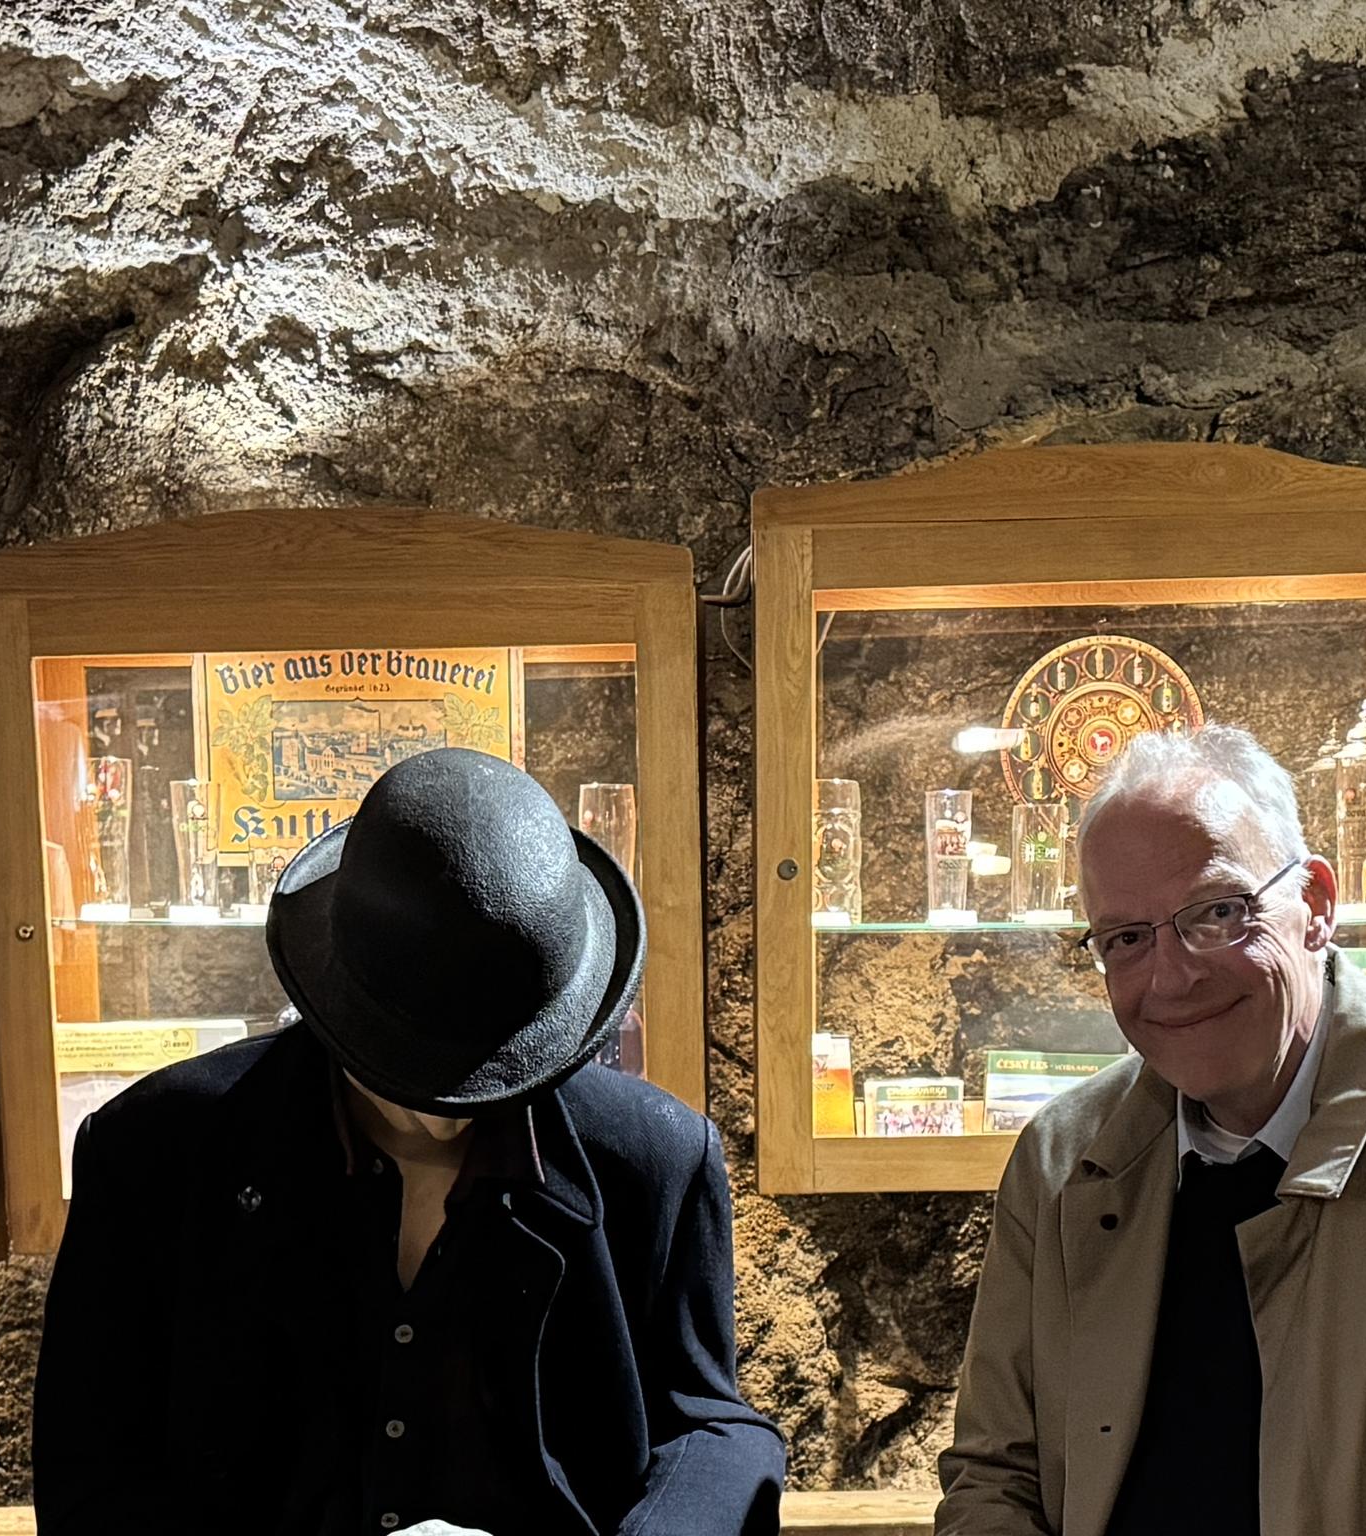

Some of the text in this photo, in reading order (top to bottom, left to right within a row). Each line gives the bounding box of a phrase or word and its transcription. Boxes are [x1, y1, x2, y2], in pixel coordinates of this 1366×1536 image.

[215, 661, 275, 694] Bier
[284, 652, 333, 683] aus
[386, 650, 496, 695] Brauerei
[231, 805, 332, 844] Kutt
